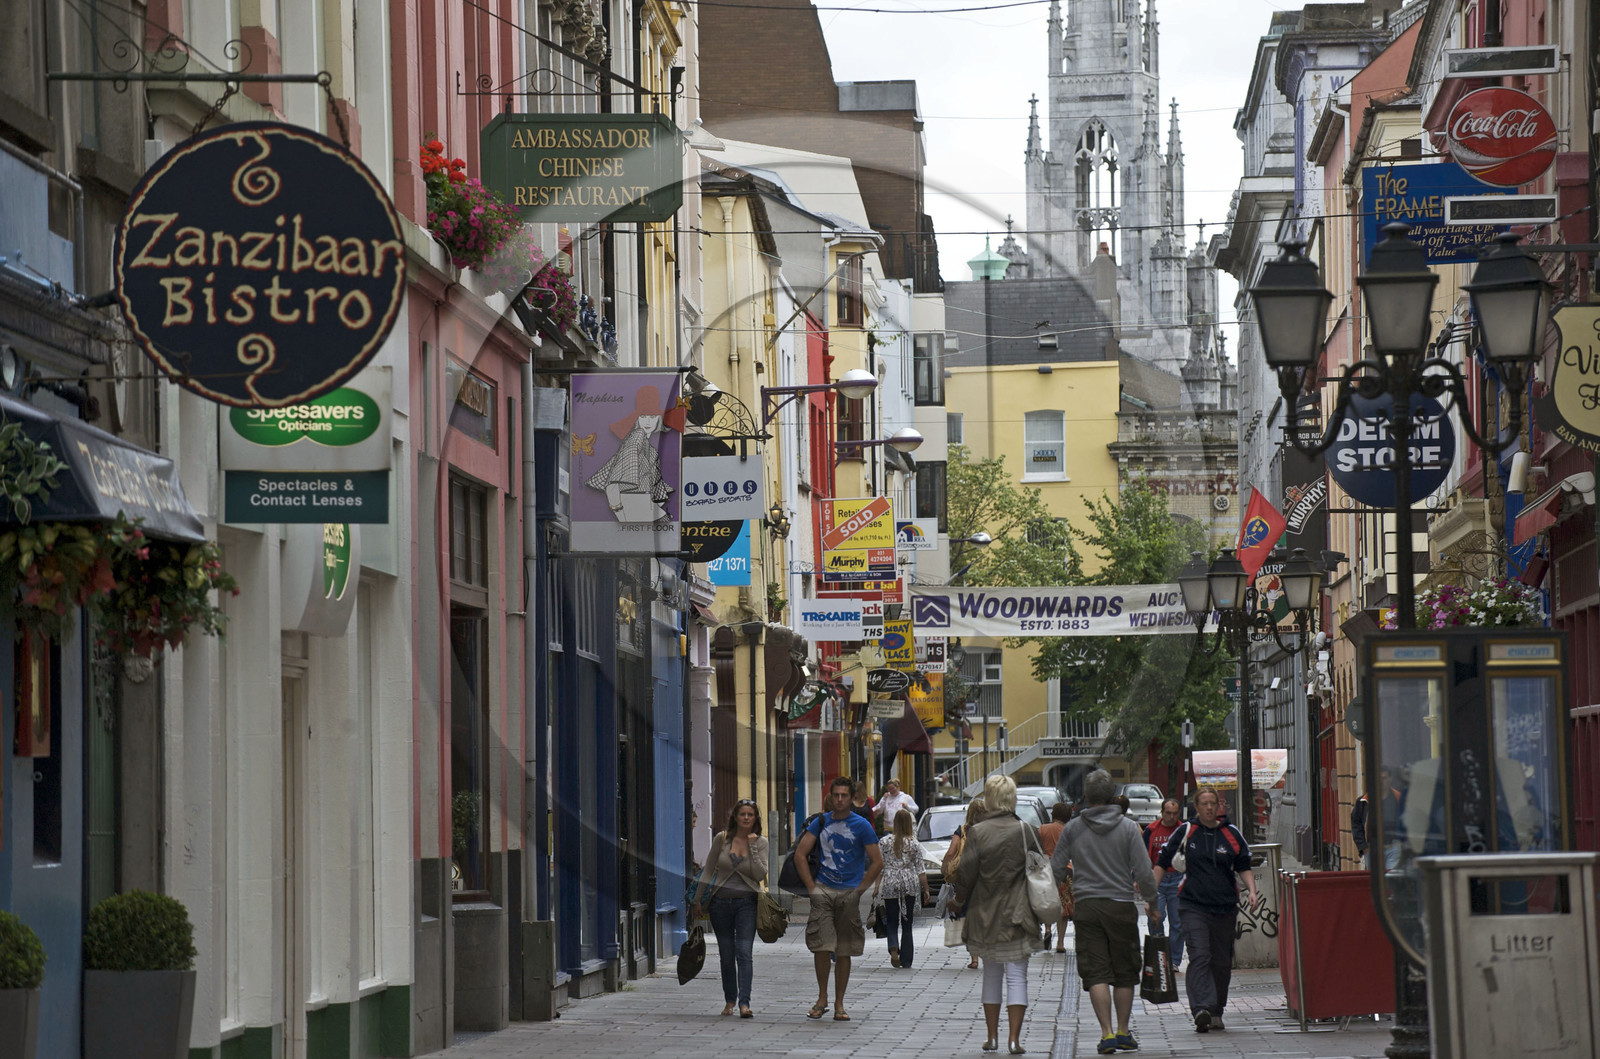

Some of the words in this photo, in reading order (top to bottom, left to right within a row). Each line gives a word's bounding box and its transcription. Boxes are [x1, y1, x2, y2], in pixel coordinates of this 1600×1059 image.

[512, 128, 651, 149] AMBASSADOR
[538, 157, 625, 178] CHINESE
[1375, 171, 1408, 197] The
[514, 186, 650, 207] RESTAURANT
[1424, 226, 1446, 238] your
[130, 213, 402, 278] Zanzibaar
[1428, 235, 1445, 248] Off
[1428, 247, 1457, 257] Value
[159, 272, 373, 329] Bistro
[1563, 344, 1600, 376] Vi
[247, 405, 365, 422] Specsavers
[278, 420, 333, 433] Opticians
[1336, 415, 1441, 443] DENM
[1556, 424, 1577, 446] BAR
[258, 479, 338, 492] Spectacles
[344, 479, 354, 491] &
[250, 493, 307, 507] Contact
[312, 493, 363, 507] Lenses
[647, 524, 675, 532] FLOOR
[840, 509, 873, 537] SOLD
[726, 557, 747, 571] 1371
[831, 555, 865, 569] Murphy
[1257, 564, 1287, 578] MURP
[864, 581, 896, 590] Global
[958, 592, 1124, 618] WOODWARDS
[1058, 619, 1090, 630] 1883
[1394, 647, 1436, 658] eircom
[1508, 646, 1550, 657] eircom
[1490, 934, 1554, 953] Litter
